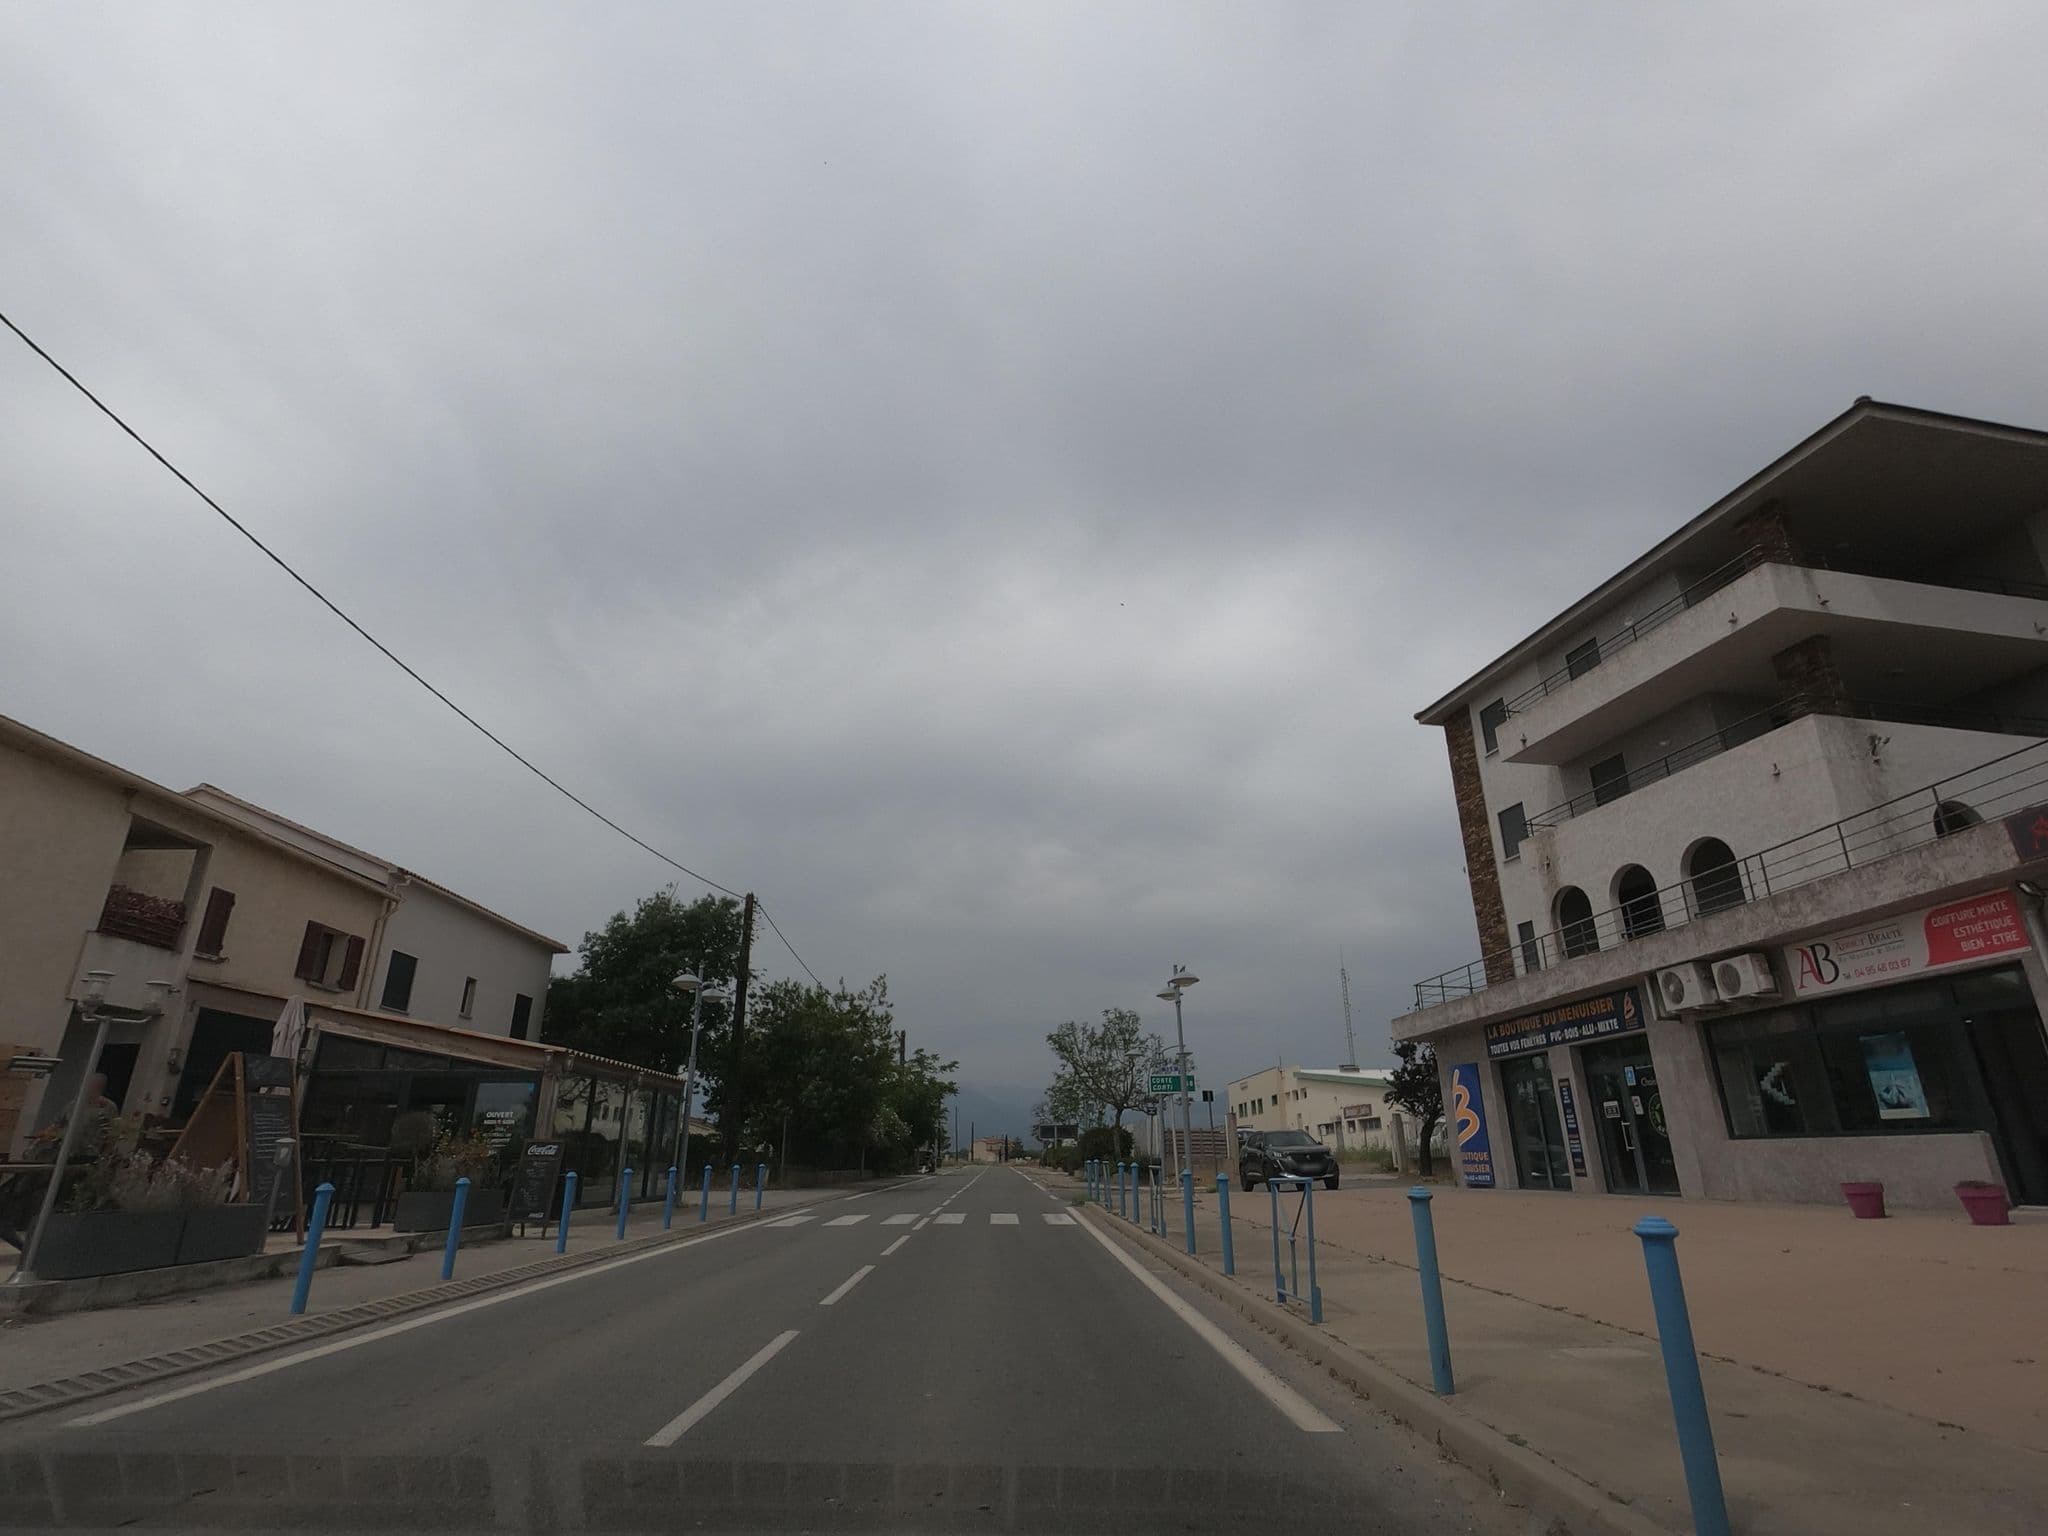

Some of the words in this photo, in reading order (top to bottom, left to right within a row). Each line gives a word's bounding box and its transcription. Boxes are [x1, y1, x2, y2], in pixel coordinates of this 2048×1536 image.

[1931, 908, 1976, 928] COIFFURE
[1976, 899, 2009, 915] MIXTE
[1960, 937, 1984, 952] BIEN
[1488, 1024, 1499, 1040] LA
[1499, 1013, 1542, 1037] BOUTIQUE
[1543, 1010, 1556, 1026] DU
[1559, 997, 1615, 1022] MENUISIER
[486, 1111, 514, 1119] OUVERT
